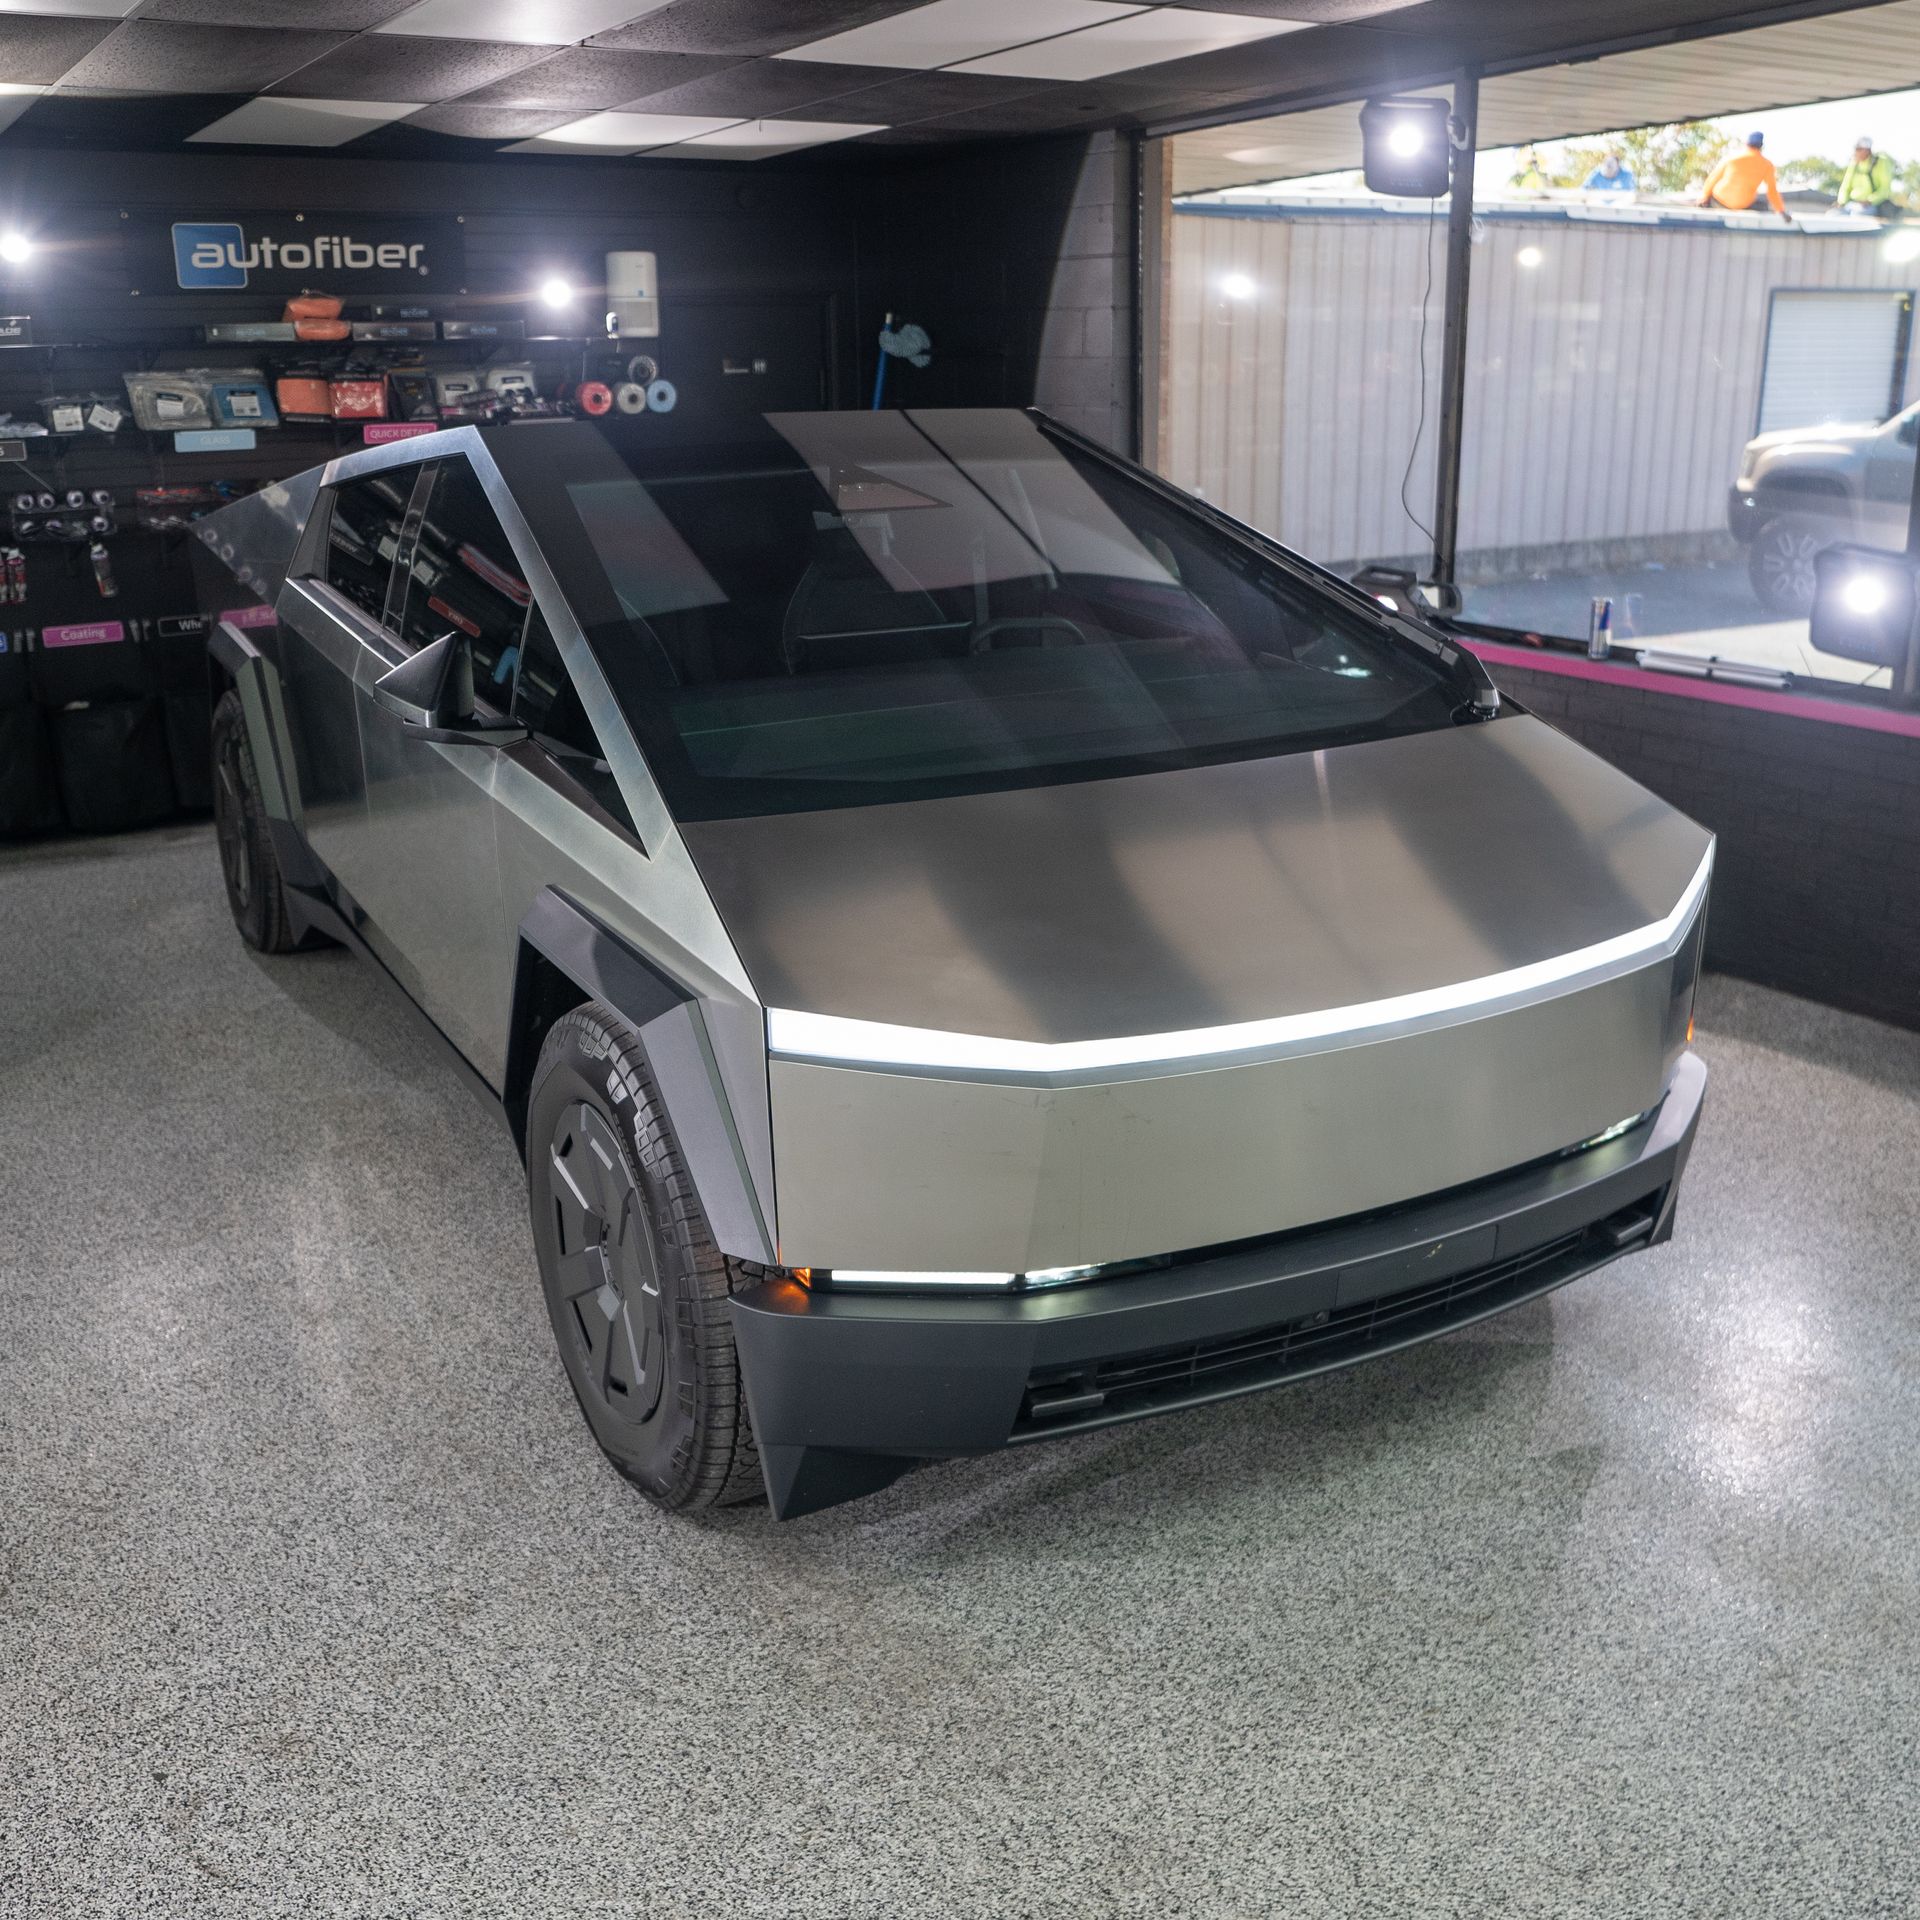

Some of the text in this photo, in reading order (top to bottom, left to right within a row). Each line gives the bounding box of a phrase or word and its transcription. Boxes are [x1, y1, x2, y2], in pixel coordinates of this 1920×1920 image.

[190, 236, 424, 270] autofiber
[199, 436, 231, 445] GLASS
[369, 430, 399, 440] QUICK
[60, 628, 106, 641] Coating
